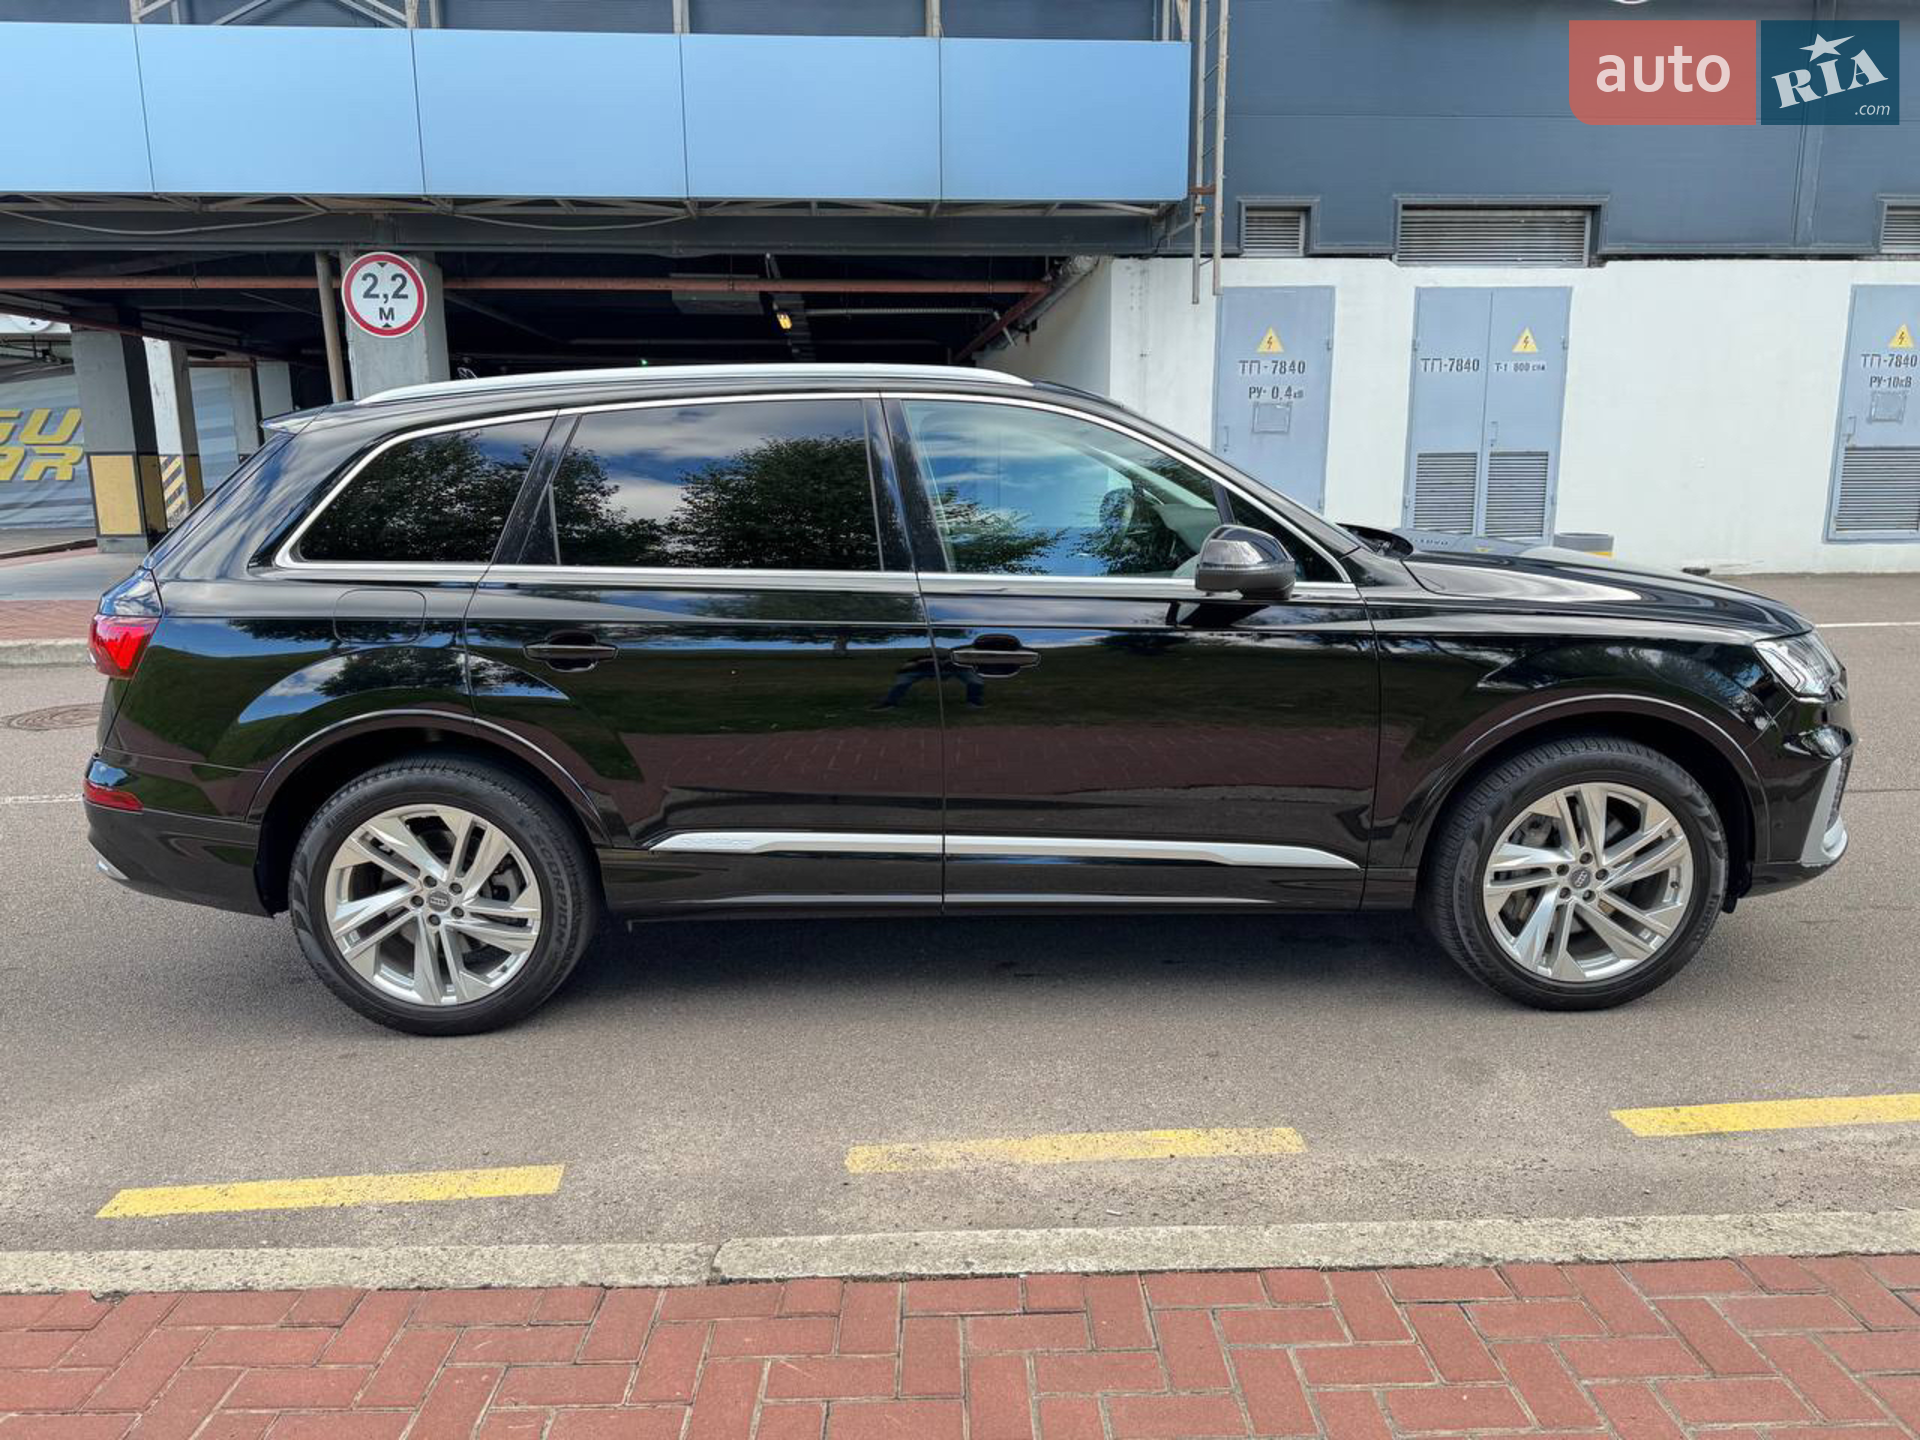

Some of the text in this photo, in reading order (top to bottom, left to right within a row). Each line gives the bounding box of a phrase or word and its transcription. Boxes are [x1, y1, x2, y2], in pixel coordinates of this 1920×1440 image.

[361, 272, 409, 304] 2,2
[1420, 358, 1480, 373] ТП-7840
[1861, 353, 1918, 368] ТП-7840
